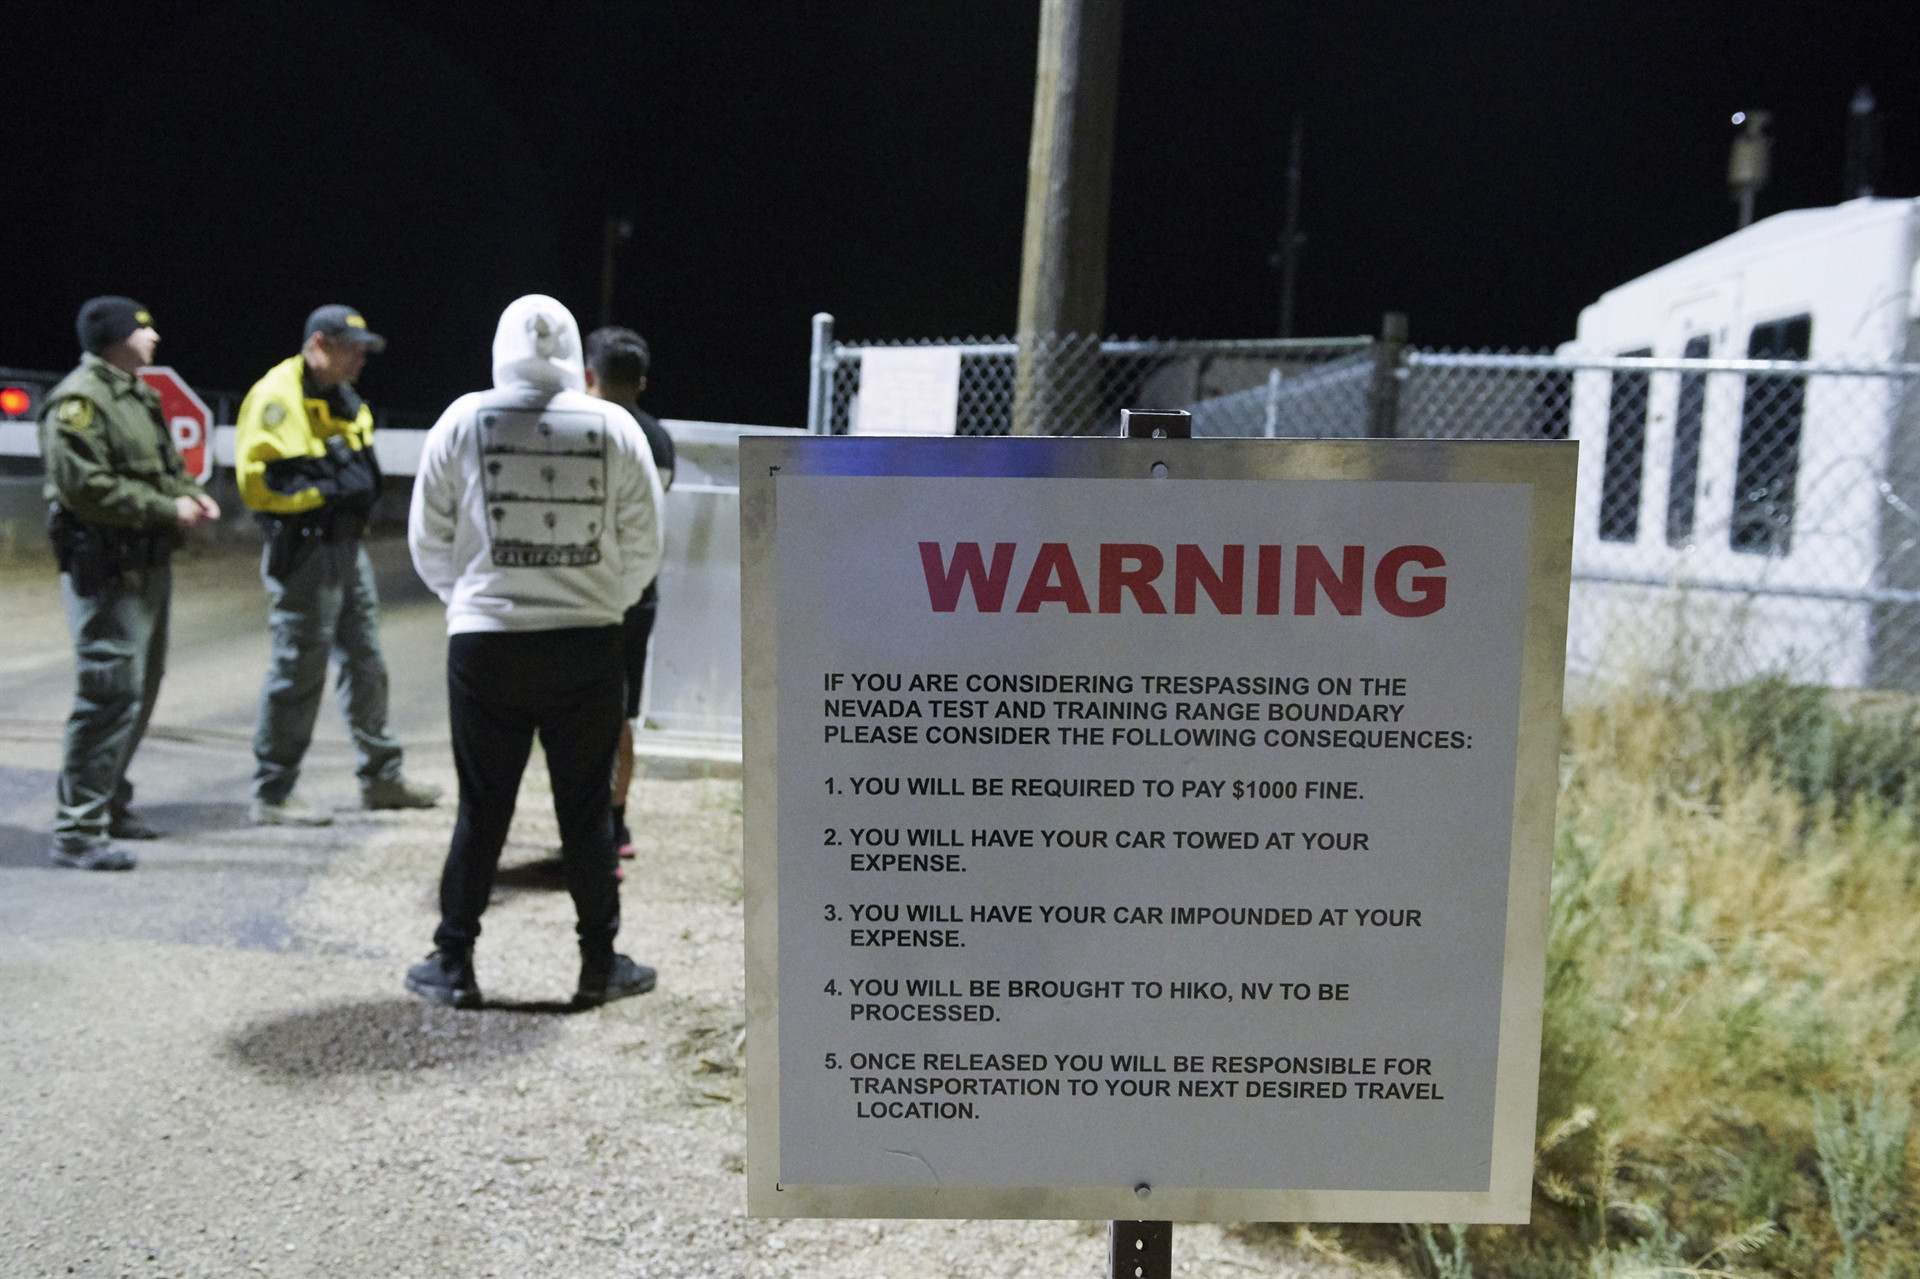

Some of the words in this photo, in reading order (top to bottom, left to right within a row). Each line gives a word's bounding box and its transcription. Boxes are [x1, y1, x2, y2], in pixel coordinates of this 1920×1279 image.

[918, 541, 1447, 616] WARNING
[825, 673, 844, 691] IF
[851, 673, 901, 692] YOU
[908, 674, 958, 692] ARE
[966, 674, 1133, 694] CONSIDERING
[1141, 676, 1309, 695] TRESPASSING
[1318, 677, 1351, 695] ON
[1360, 678, 1406, 696] THE
[825, 699, 922, 718] NEVADA
[928, 700, 989, 718] TEST
[995, 701, 1045, 719] AND
[1053, 701, 1167, 720] TRAINING
[1176, 703, 1260, 721] RANGE
[1269, 703, 1404, 722] BOUNDARY
[825, 725, 918, 744] PLEASE
[926, 726, 1050, 745] CONSIDER
[1058, 727, 1104, 745] THE
[1112, 728, 1256, 747] FOLLOWING
[1264, 729, 1472, 749] CONSEQUENCES:
[825, 777, 842, 795] 1.
[850, 777, 899, 795] YOU
[907, 778, 965, 795] WILL
[972, 778, 1003, 796] BE
[1012, 779, 1135, 798] REQUIRED
[1142, 780, 1174, 798] TO
[1182, 780, 1226, 798] PAY
[1233, 780, 1297, 800] $1000
[1305, 781, 1363, 799] FINE.
[824, 828, 842, 846] 2.
[850, 828, 899, 846] YOU
[907, 829, 964, 847] WILL
[972, 829, 1033, 847] HAVE
[1041, 830, 1108, 848] YOUR
[1116, 831, 1165, 848] CAR
[1173, 831, 1259, 849] TOWED
[1265, 832, 1295, 850] AT
[1302, 833, 1369, 850] YOUR
[851, 854, 966, 872] EXPENSE.
[824, 904, 842, 921] 3.
[849, 904, 899, 922] YOU
[906, 905, 963, 922] WILL
[971, 905, 1032, 923] HAVE
[1039, 906, 1106, 923] YOUR
[1114, 906, 1163, 924] CAR
[1171, 907, 1312, 925] IMPOUNDED
[1319, 909, 1348, 926] AT
[1355, 909, 1421, 927] YOUR
[851, 929, 965, 947] EXPENSE.
[824, 979, 842, 996] 4.
[849, 979, 898, 996] YOU
[906, 980, 962, 997] WILL
[970, 980, 1000, 997] BE
[1008, 980, 1125, 998] BROUGHT
[1131, 982, 1162, 999] TO
[1170, 982, 1233, 1002] HIKO,
[1242, 983, 1273, 1000] NV
[1279, 983, 1311, 1000] TO
[1318, 984, 1349, 1001] BE
[851, 1004, 1000, 1022] PROCESSED.
[825, 1053, 842, 1069] 5.
[850, 1053, 915, 1070] ONCE
[924, 1054, 1047, 1071] RELEASED
[1054, 1055, 1103, 1072] YOU
[1110, 1055, 1166, 1072] WILL
[1174, 1056, 1204, 1073] BE
[1212, 1056, 1376, 1075] RESPONSIBLE
[1384, 1058, 1431, 1075] FOR
[850, 1077, 1059, 1095] TRANSPORTATION
[1067, 1079, 1098, 1096] TO
[1105, 1079, 1170, 1097] YOUR
[1178, 1080, 1239, 1097] NEXT
[1246, 1081, 1347, 1099] DESIRED
[1354, 1082, 1444, 1100] TRAVEL
[857, 1102, 979, 1119] LOCATION.
